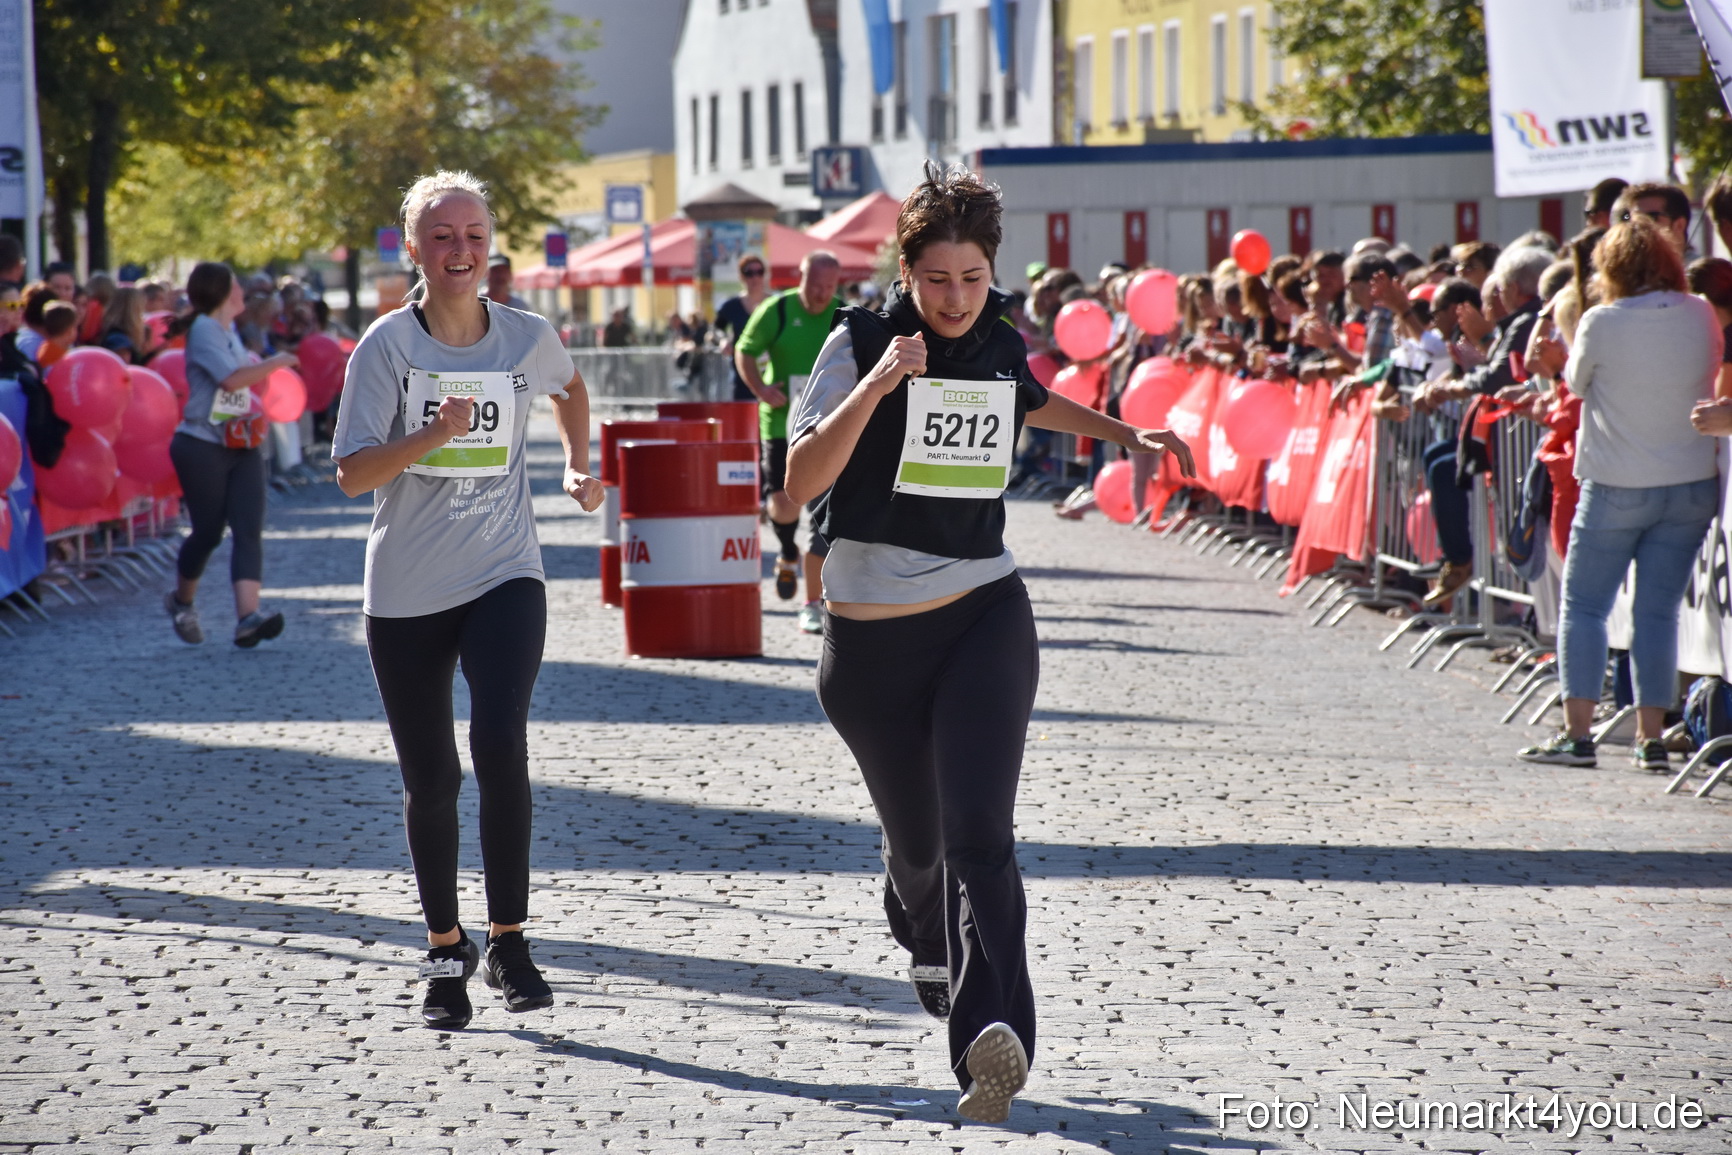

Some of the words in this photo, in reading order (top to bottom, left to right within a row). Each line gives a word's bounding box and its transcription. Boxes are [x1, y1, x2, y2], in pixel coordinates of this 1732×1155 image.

[440, 381, 484, 392] BOCK
[943, 390, 988, 403] BOCK
[422, 400, 499, 432] 509
[923, 412, 1000, 448] 5212
[454, 478, 480, 496] 19.
[622, 535, 651, 564] VIA
